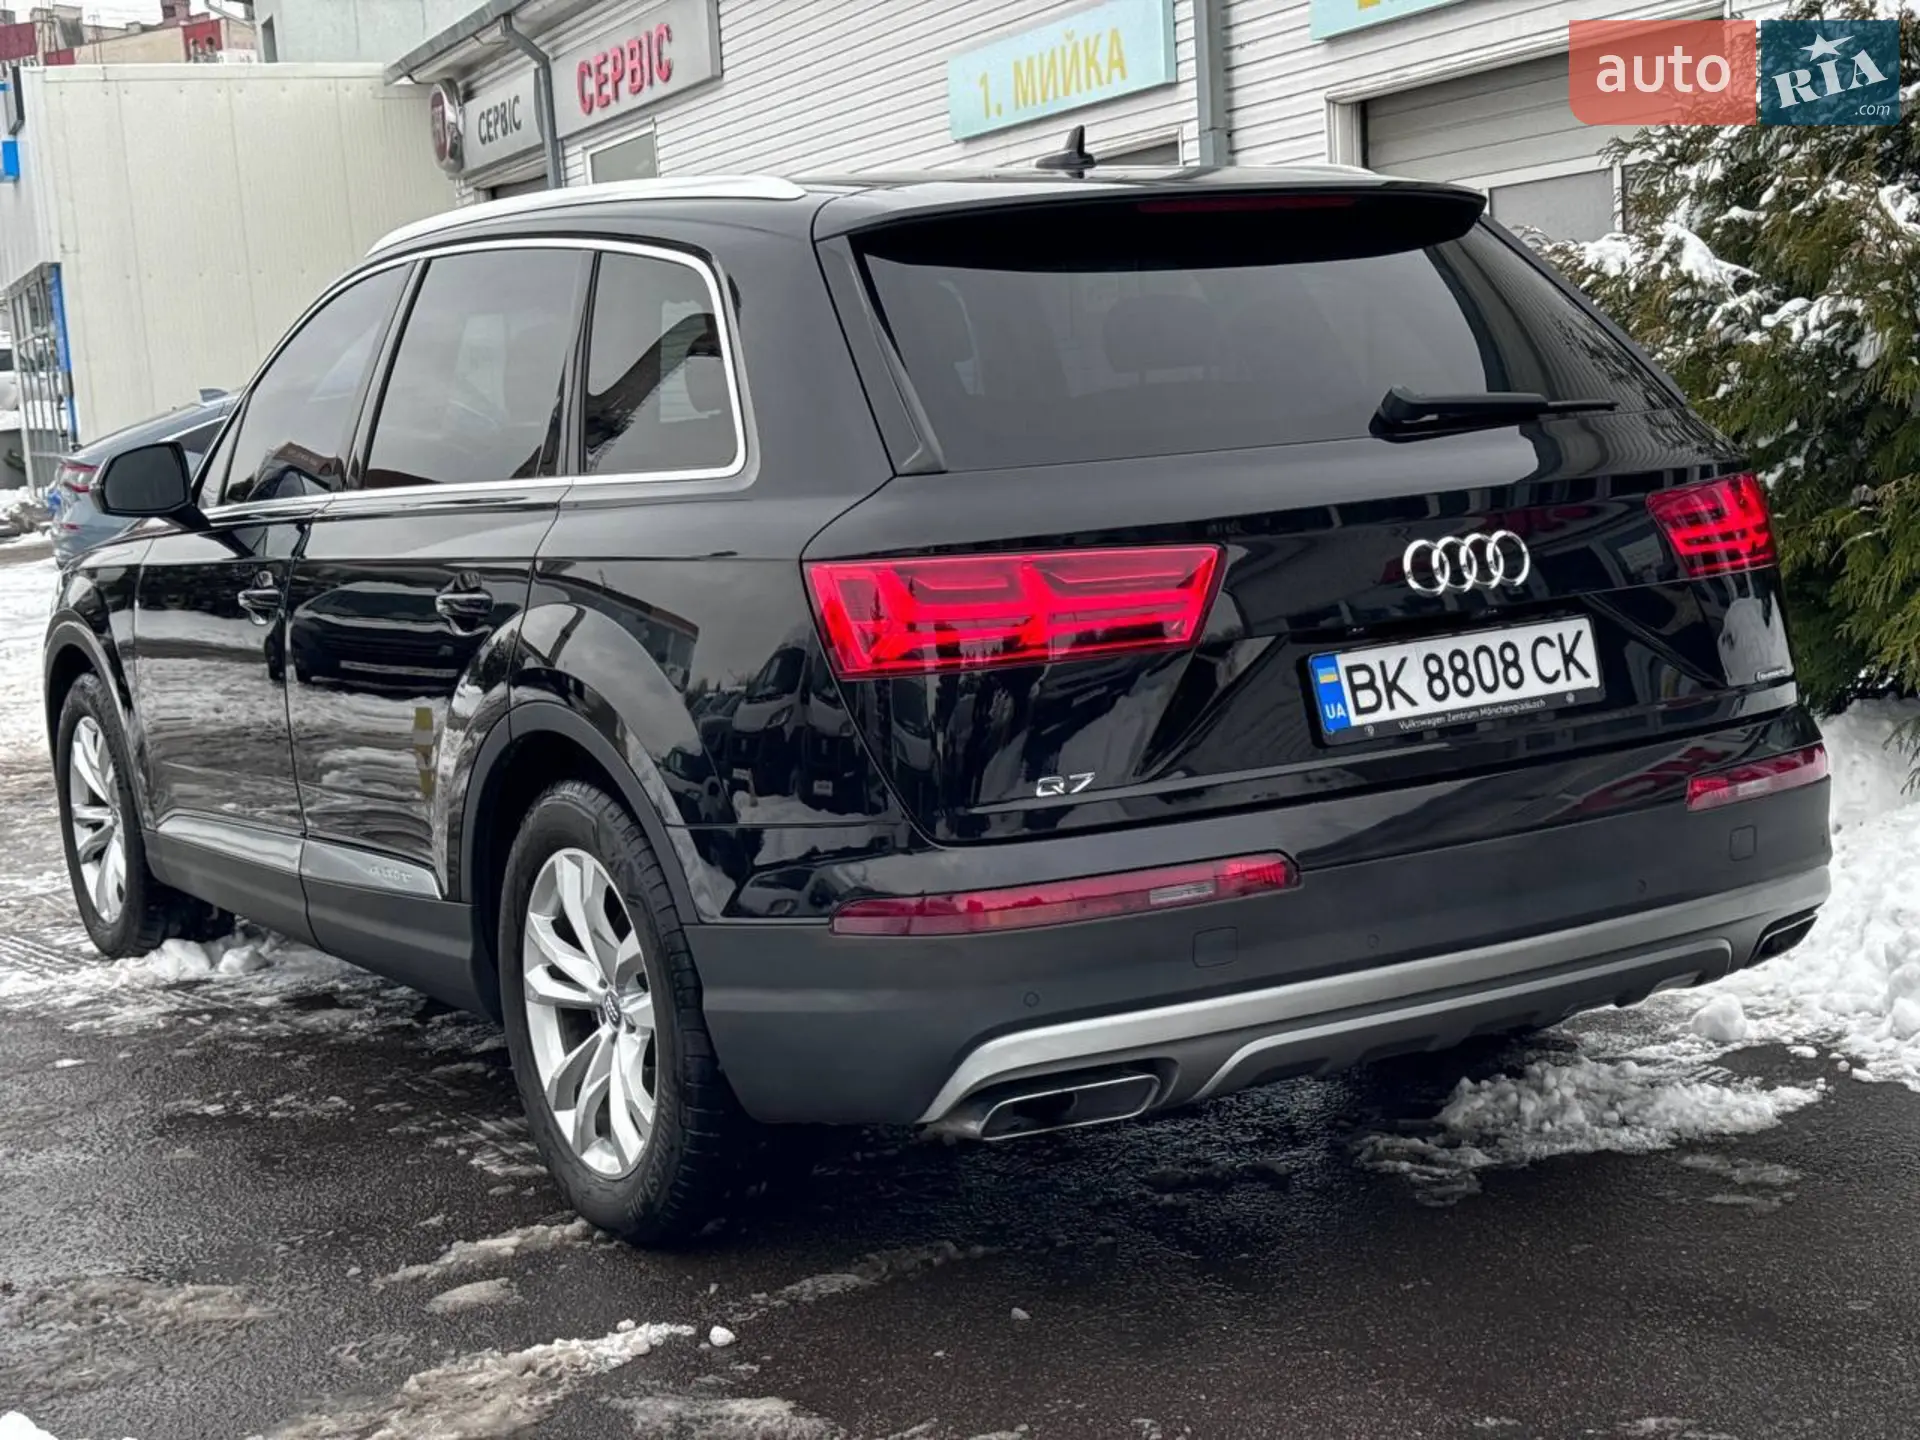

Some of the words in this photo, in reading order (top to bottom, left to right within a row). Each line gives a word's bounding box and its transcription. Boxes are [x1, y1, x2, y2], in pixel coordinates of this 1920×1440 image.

[576, 22, 673, 117] СЕРВІС
[1011, 27, 1129, 111] МИЙКА
[477, 95, 523, 146] СЕРВІС
[1345, 656, 1419, 717] BK
[1422, 641, 1525, 703] 8808
[1531, 629, 1592, 685] CK
[1325, 702, 1347, 720] UA
[1036, 771, 1096, 797] Q7
